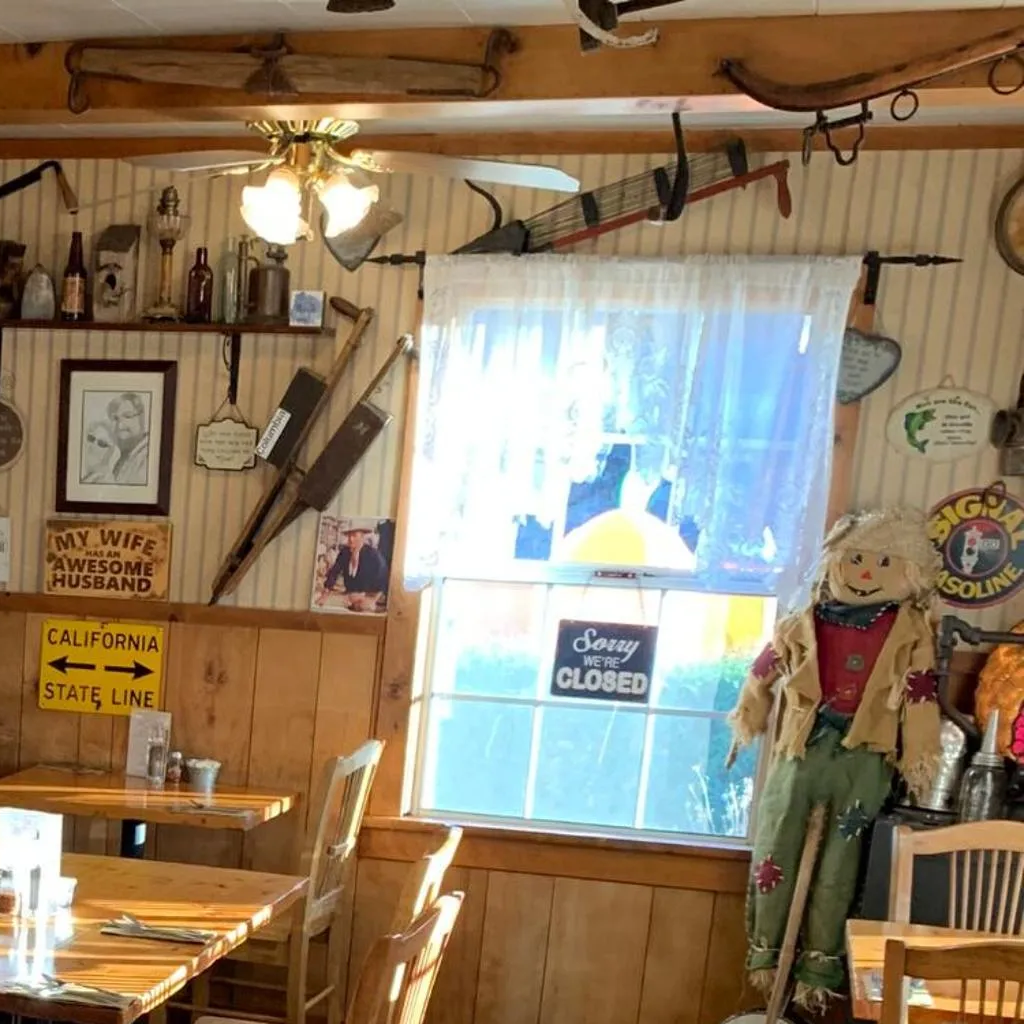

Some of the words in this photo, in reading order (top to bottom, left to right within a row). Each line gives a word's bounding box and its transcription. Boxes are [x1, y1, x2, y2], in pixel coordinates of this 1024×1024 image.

[54, 530, 90, 551] MY
[100, 529, 158, 558] WIFE
[85, 550, 104, 558] HAS
[106, 551, 121, 559] AN
[51, 557, 154, 577] AWESOME
[51, 573, 152, 593] HUSBAND
[935, 562, 1024, 599] ASOLINE
[47, 628, 160, 653] CALIFORNIA
[572, 627, 641, 664] Sorry
[583, 654, 621, 669] WE'RE
[556, 666, 649, 695] CLOSED
[43, 682, 102, 704] STATE
[111, 687, 155, 708] LINE
